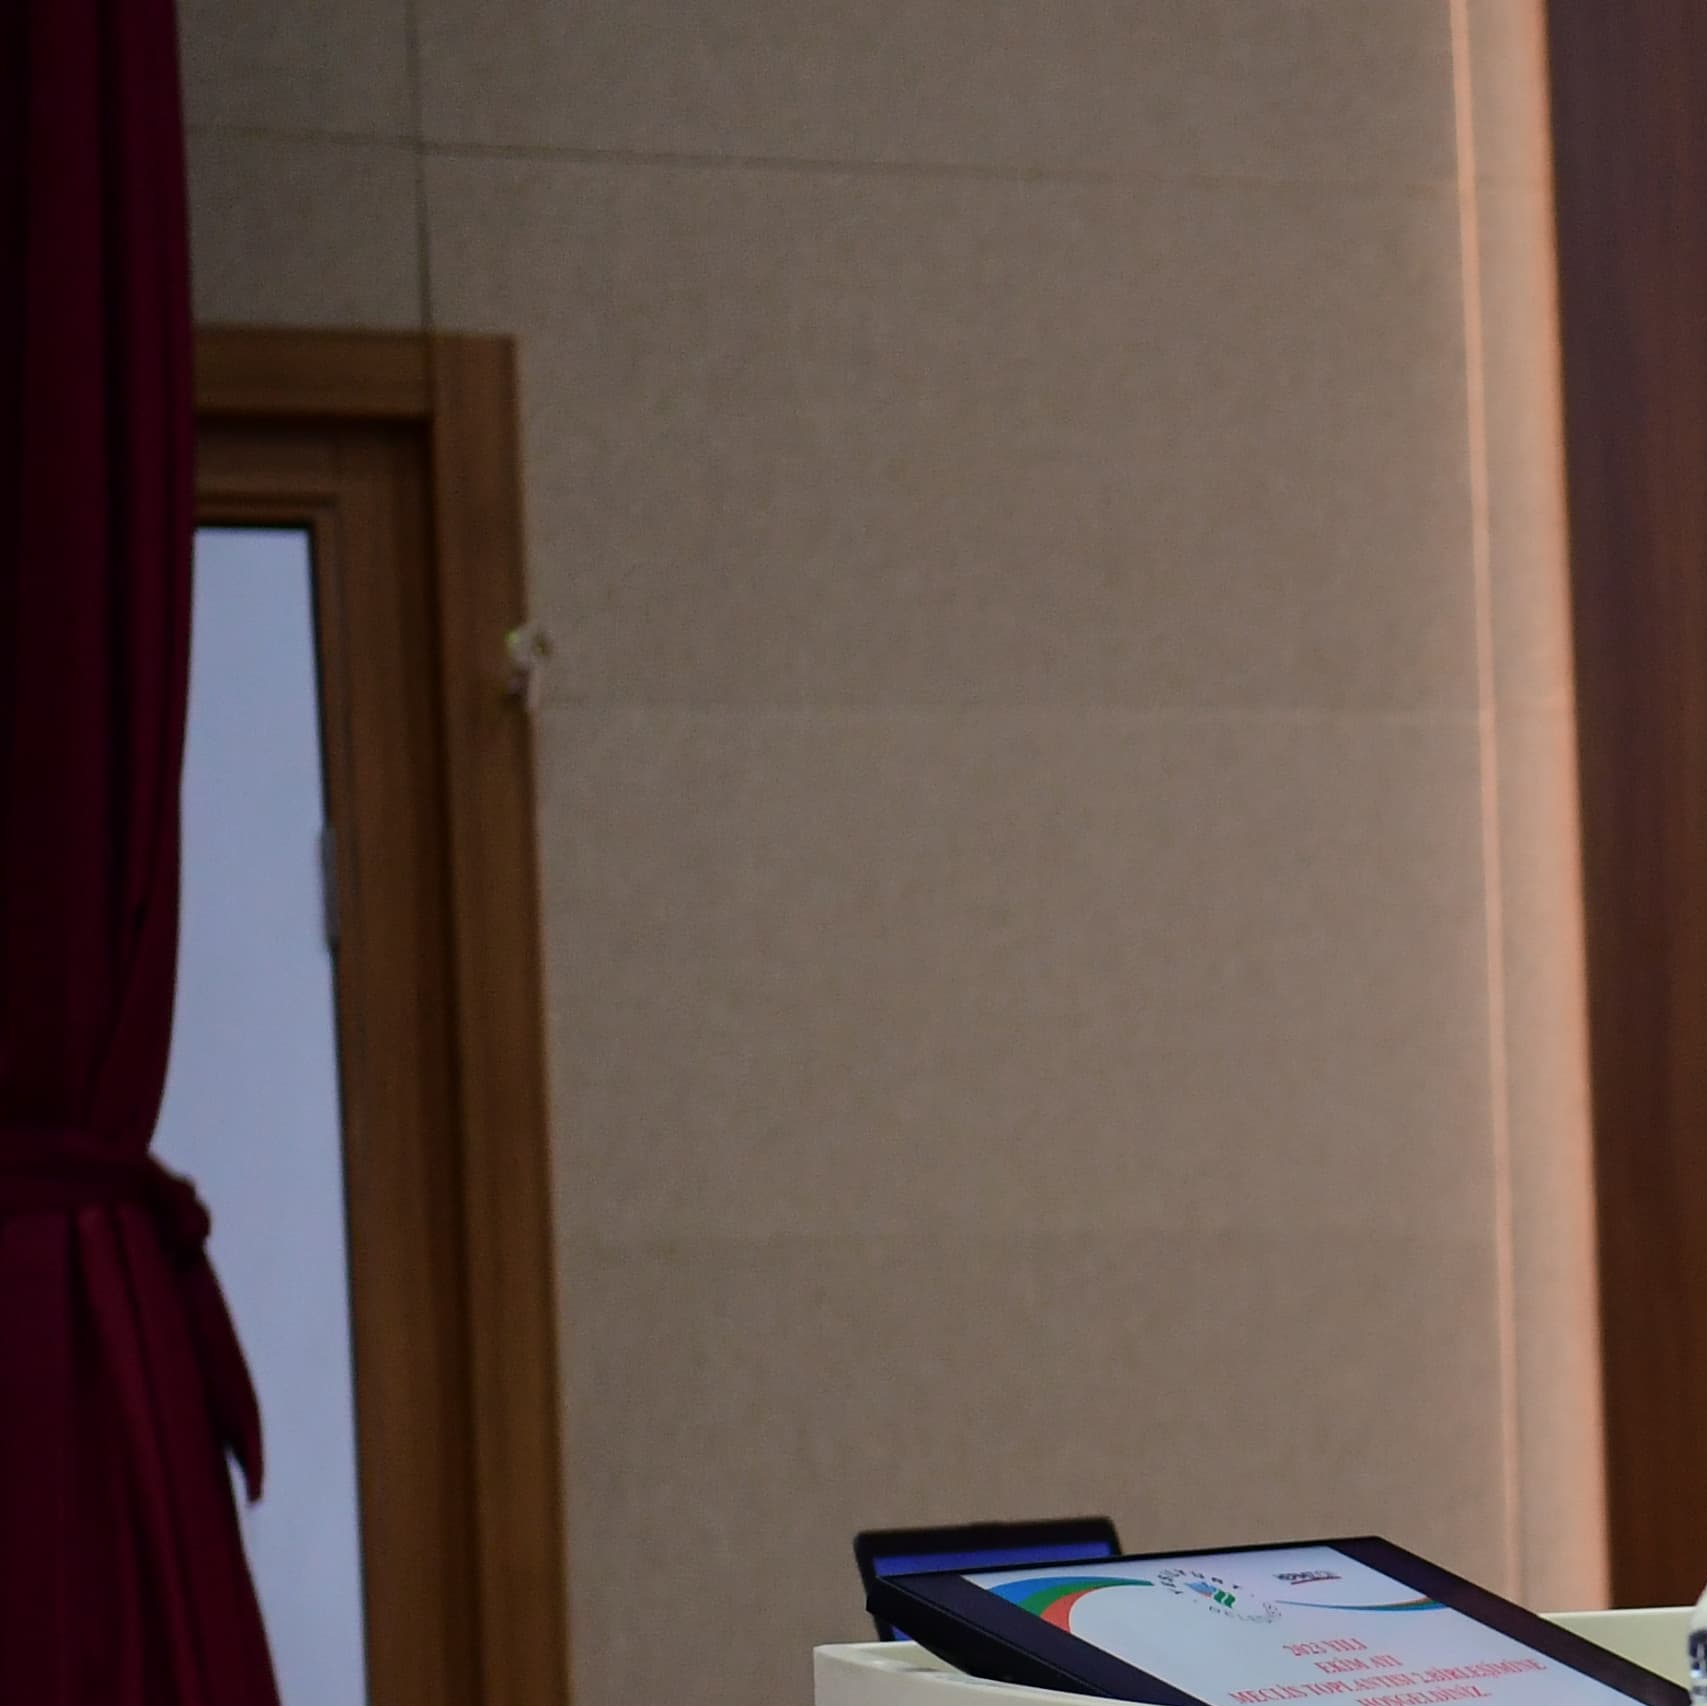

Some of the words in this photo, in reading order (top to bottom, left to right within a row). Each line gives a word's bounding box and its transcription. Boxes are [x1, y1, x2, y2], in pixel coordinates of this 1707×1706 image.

[1282, 1643, 1328, 1656] 2023
[1324, 1638, 1368, 1651] YILI
[1314, 1656, 1370, 1674] EKİM
[1370, 1655, 1403, 1667] AYI
[1228, 1684, 1308, 1704] MECLİS
[1301, 1672, 1416, 1696] TOPLANTISI
